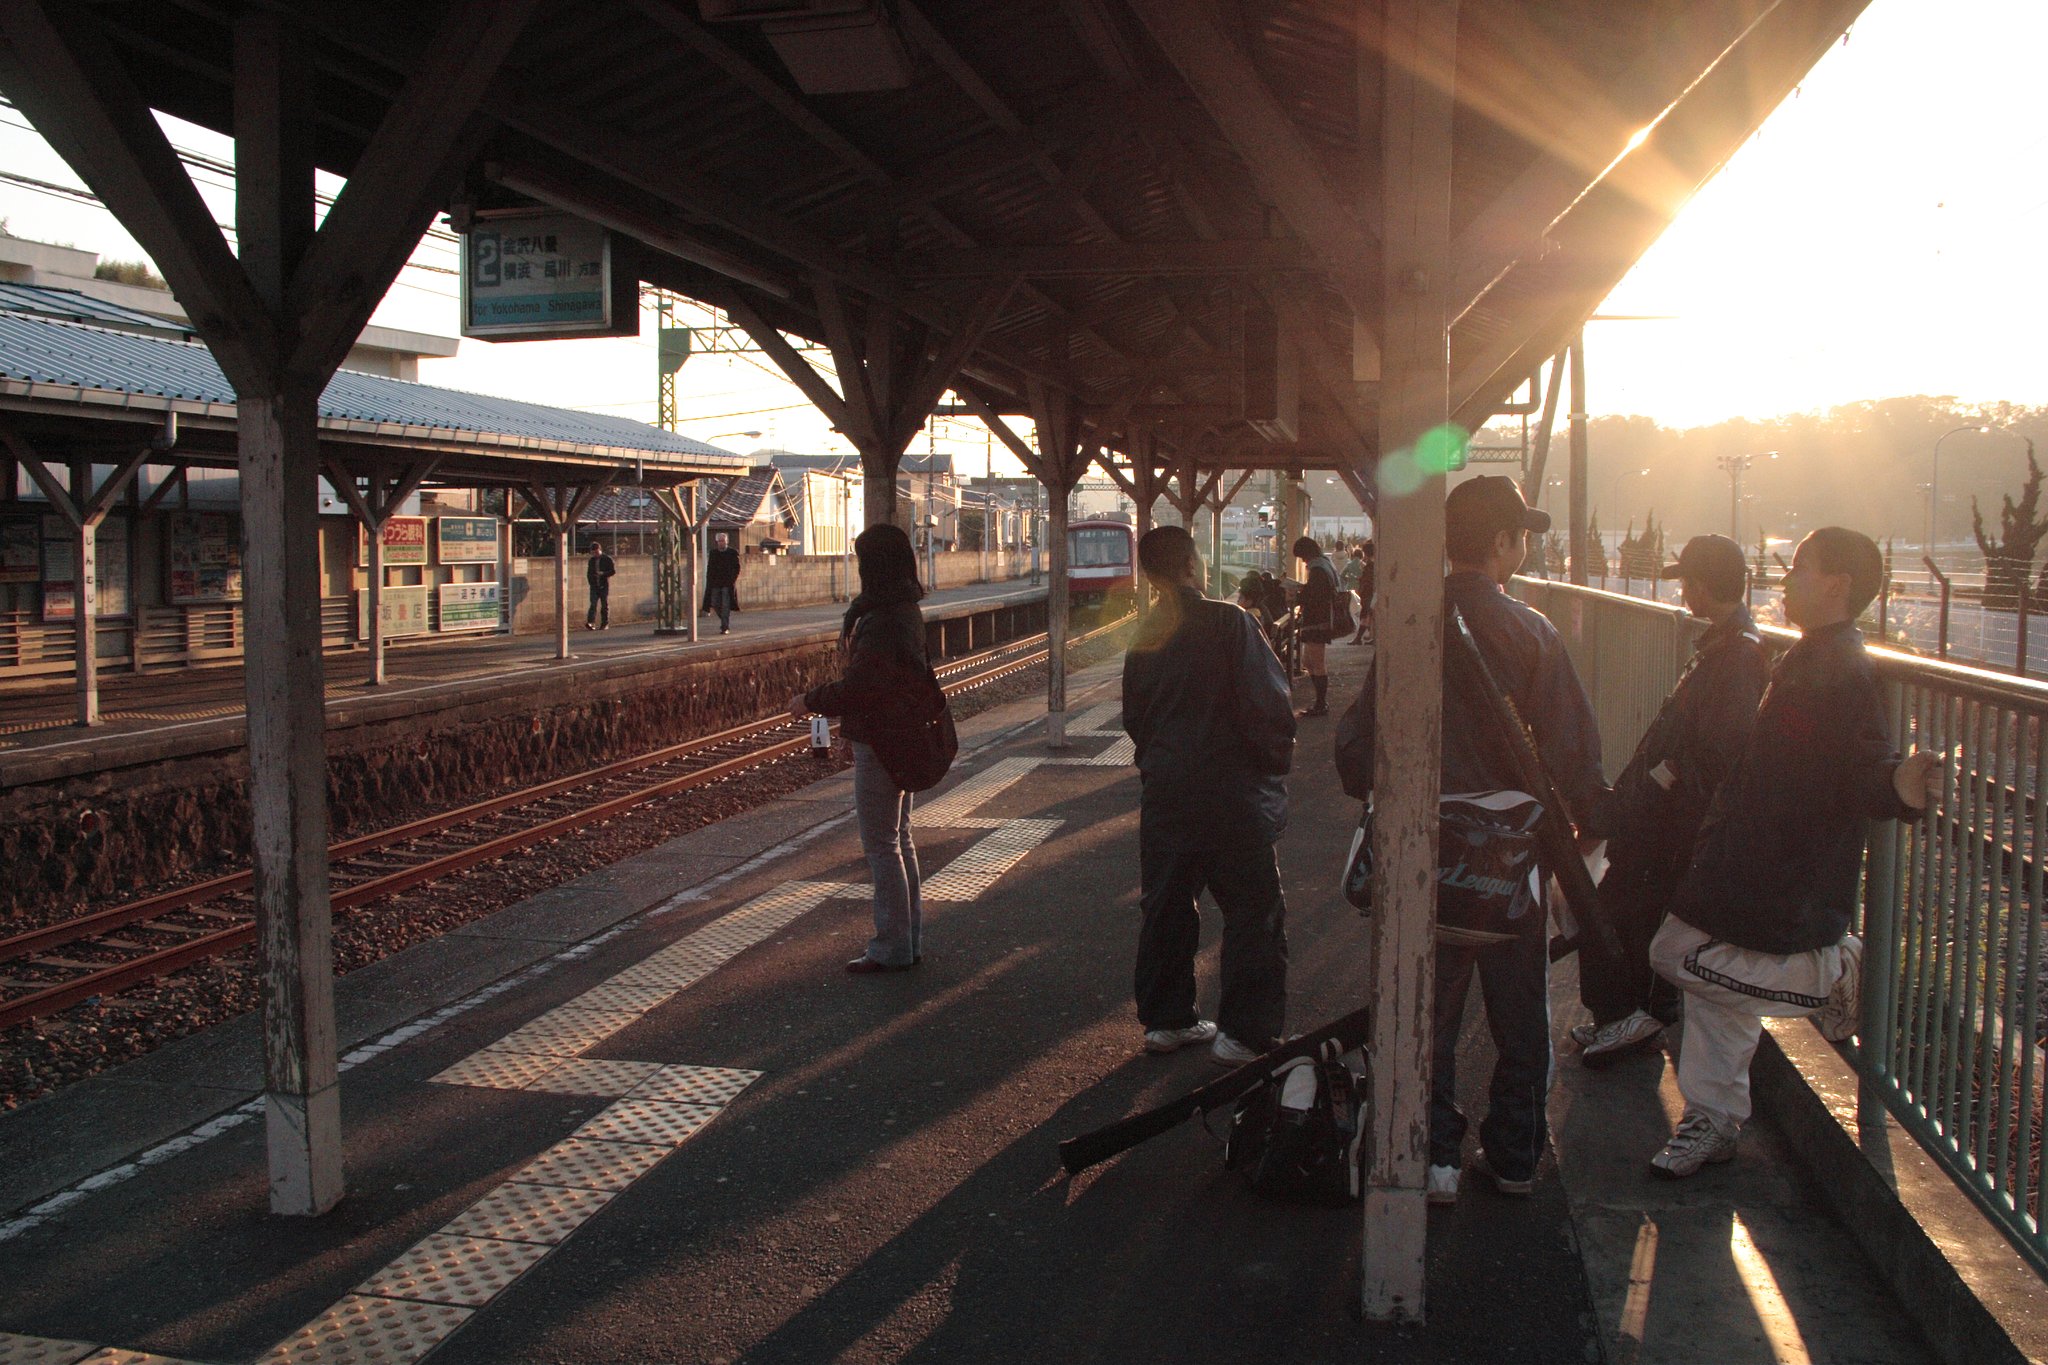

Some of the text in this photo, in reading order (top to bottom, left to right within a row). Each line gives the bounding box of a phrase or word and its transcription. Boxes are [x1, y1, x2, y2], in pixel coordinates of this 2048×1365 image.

[478, 238, 497, 282] 2
[545, 259, 571, 278] 品川
[491, 302, 541, 315] Yokohama
[548, 299, 601, 314] Shinagawa
[86, 536, 94, 604] じんむじ
[1441, 863, 1519, 900] Leagu
